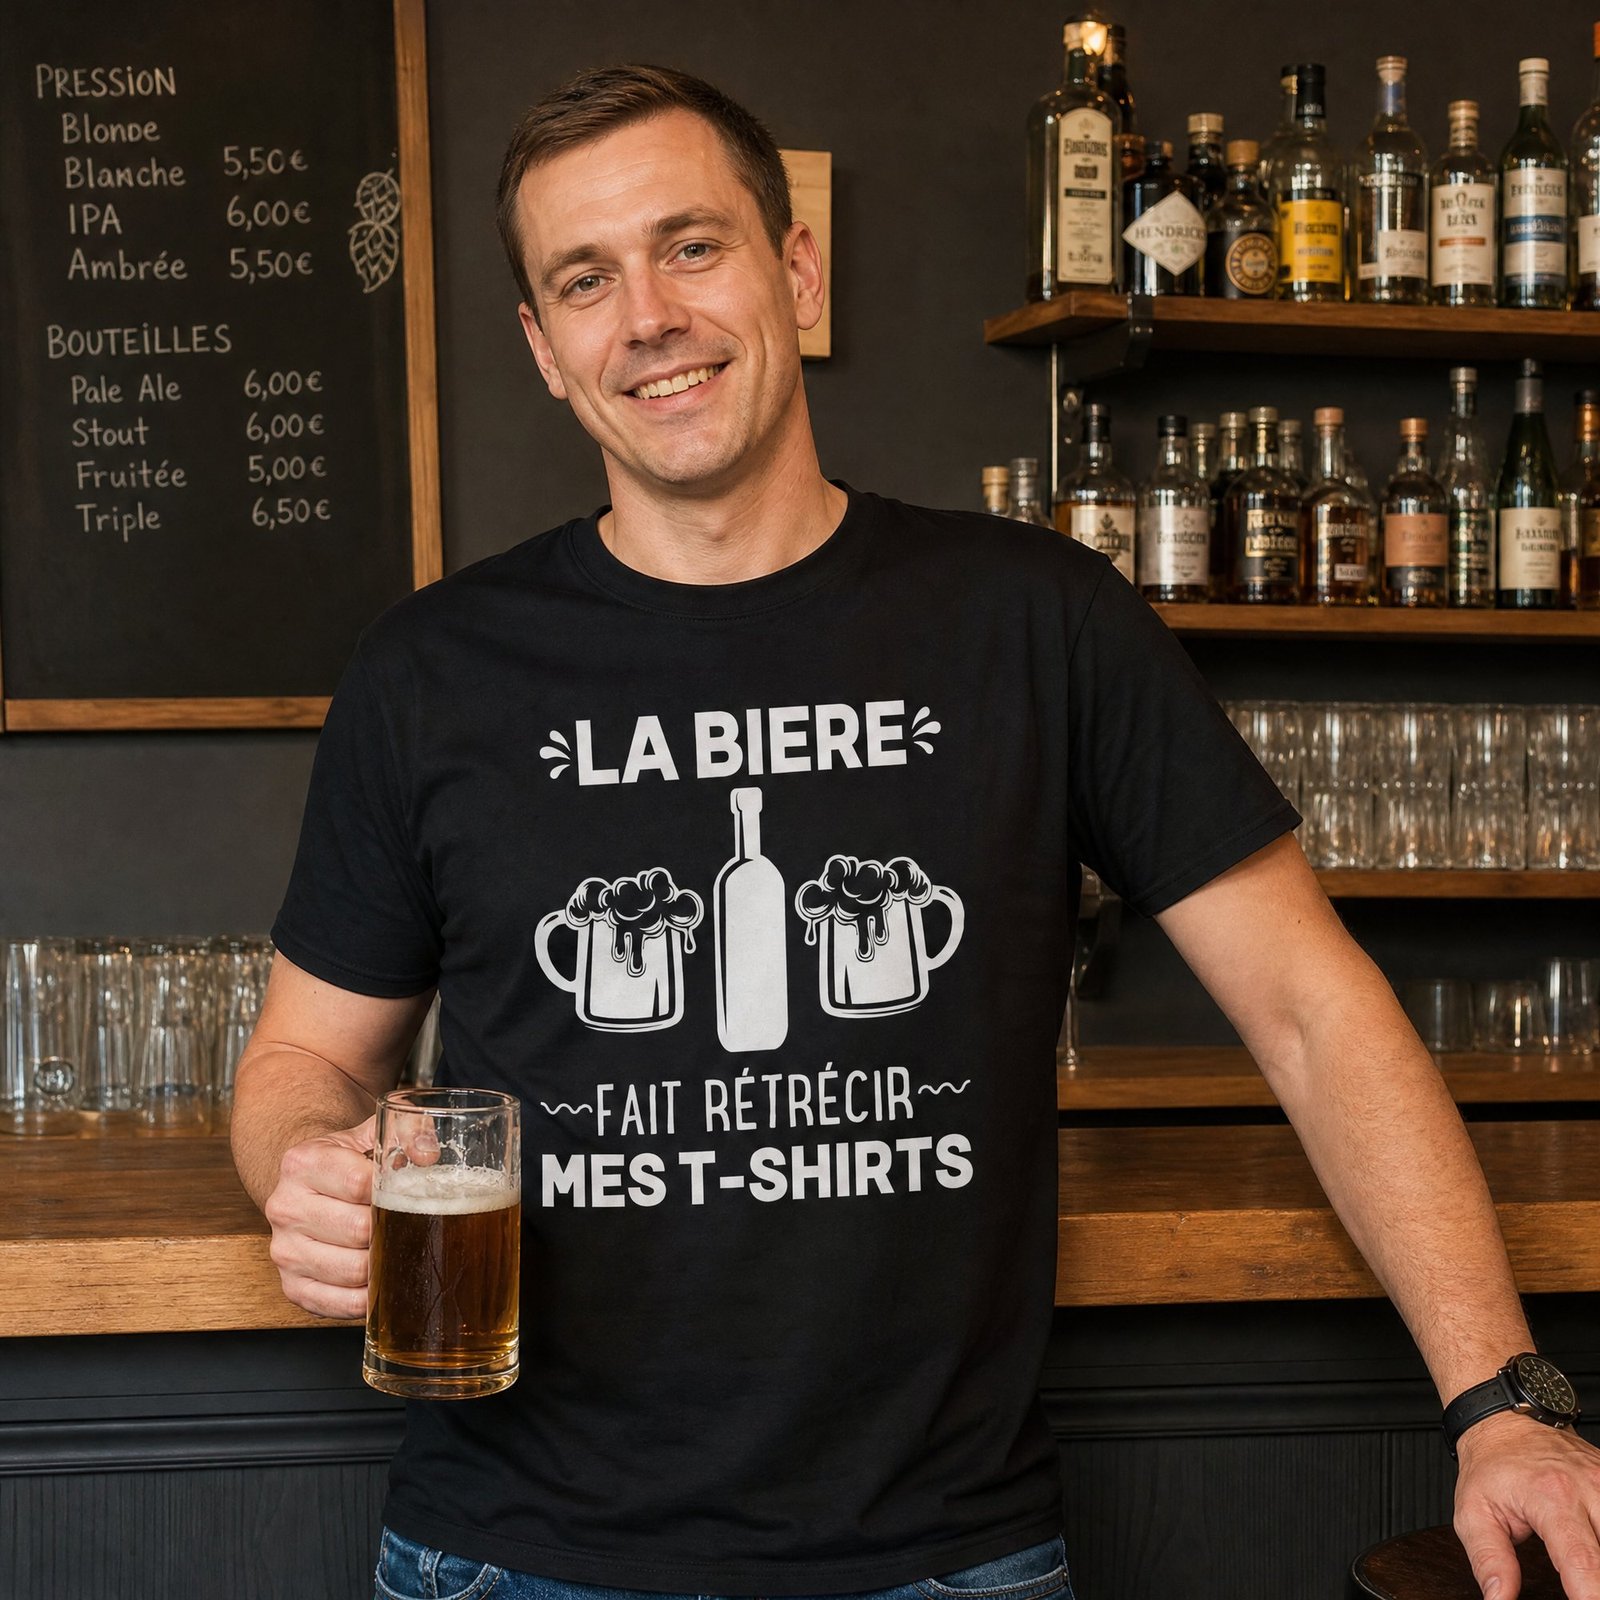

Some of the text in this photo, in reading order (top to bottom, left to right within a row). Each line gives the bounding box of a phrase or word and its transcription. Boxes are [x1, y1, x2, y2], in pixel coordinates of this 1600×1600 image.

[65, 146, 309, 189] Blanche 5,50€
[69, 195, 312, 235] IPA 6,00€
[67, 247, 314, 284] Ambrée 5,50€
[71, 369, 323, 405] Pale Ale 6,00€
[71, 411, 325, 447] Stout 6,00€
[77, 454, 327, 490] Fruitée 5,00€
[75, 498, 331, 543] Triple 6,50€
[575, 699, 908, 786] LA BIERE
[596, 1061, 914, 1137] FAIT RÉTRÉCIR
[541, 1133, 974, 1208] MES T-SHIRTS
